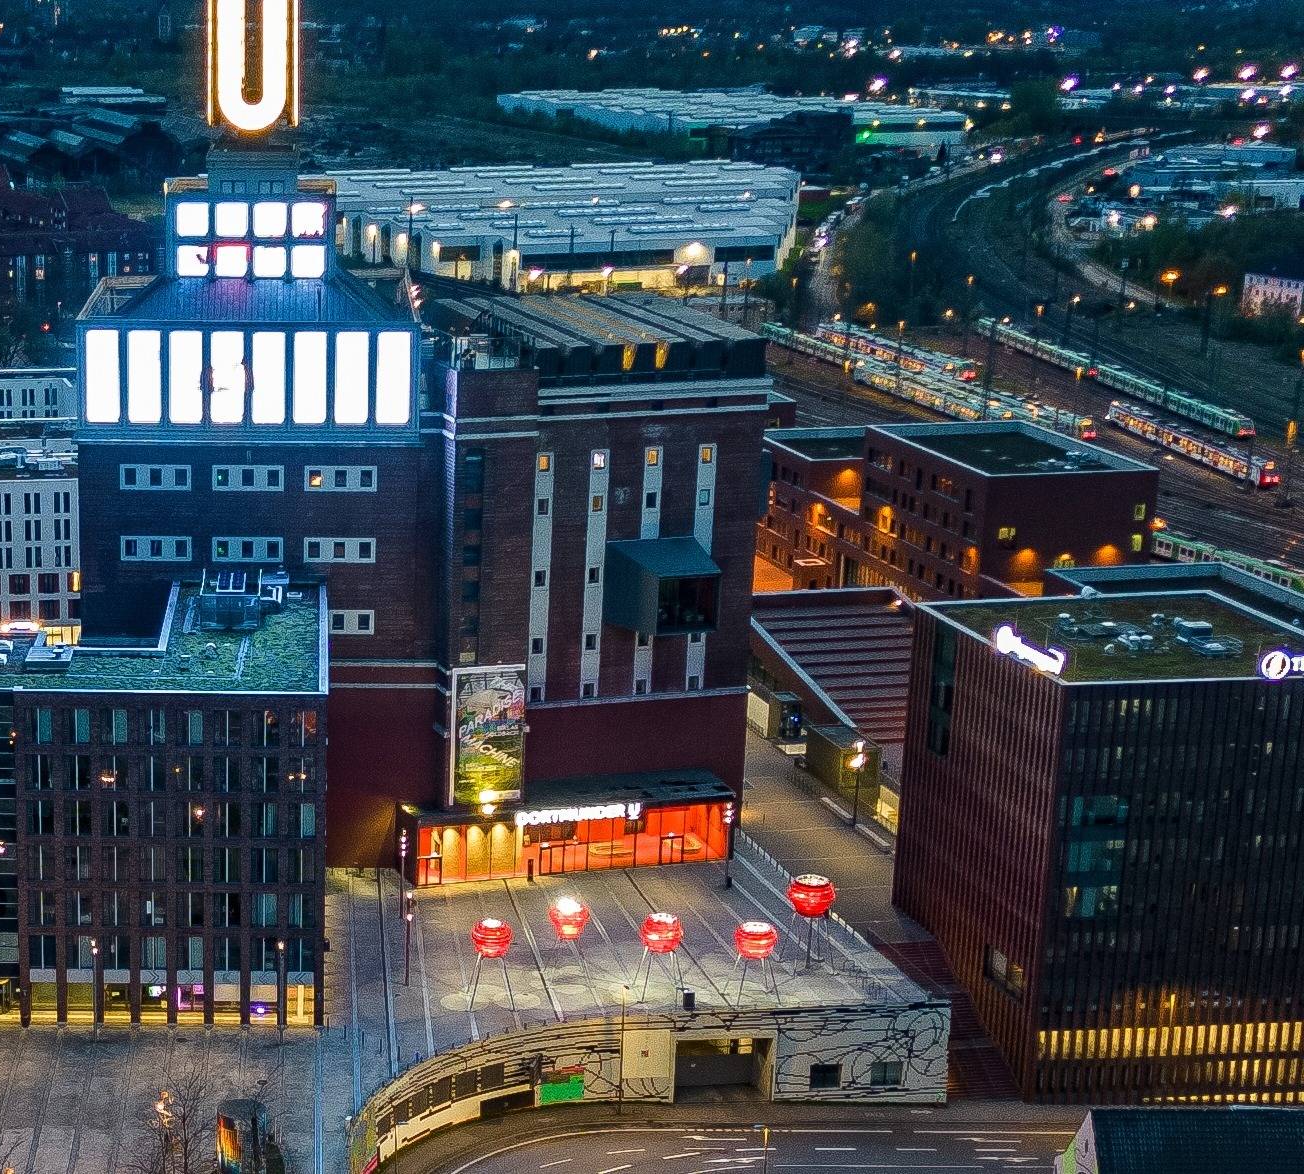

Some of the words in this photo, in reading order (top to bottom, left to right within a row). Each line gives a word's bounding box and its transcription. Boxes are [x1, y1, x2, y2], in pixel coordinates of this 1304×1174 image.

[214, 0, 290, 133] U
[459, 689, 525, 738] PARADISE
[459, 735, 520, 768] MACHINE
[515, 804, 626, 826] DORTMUNDER
[627, 802, 641, 820] U
